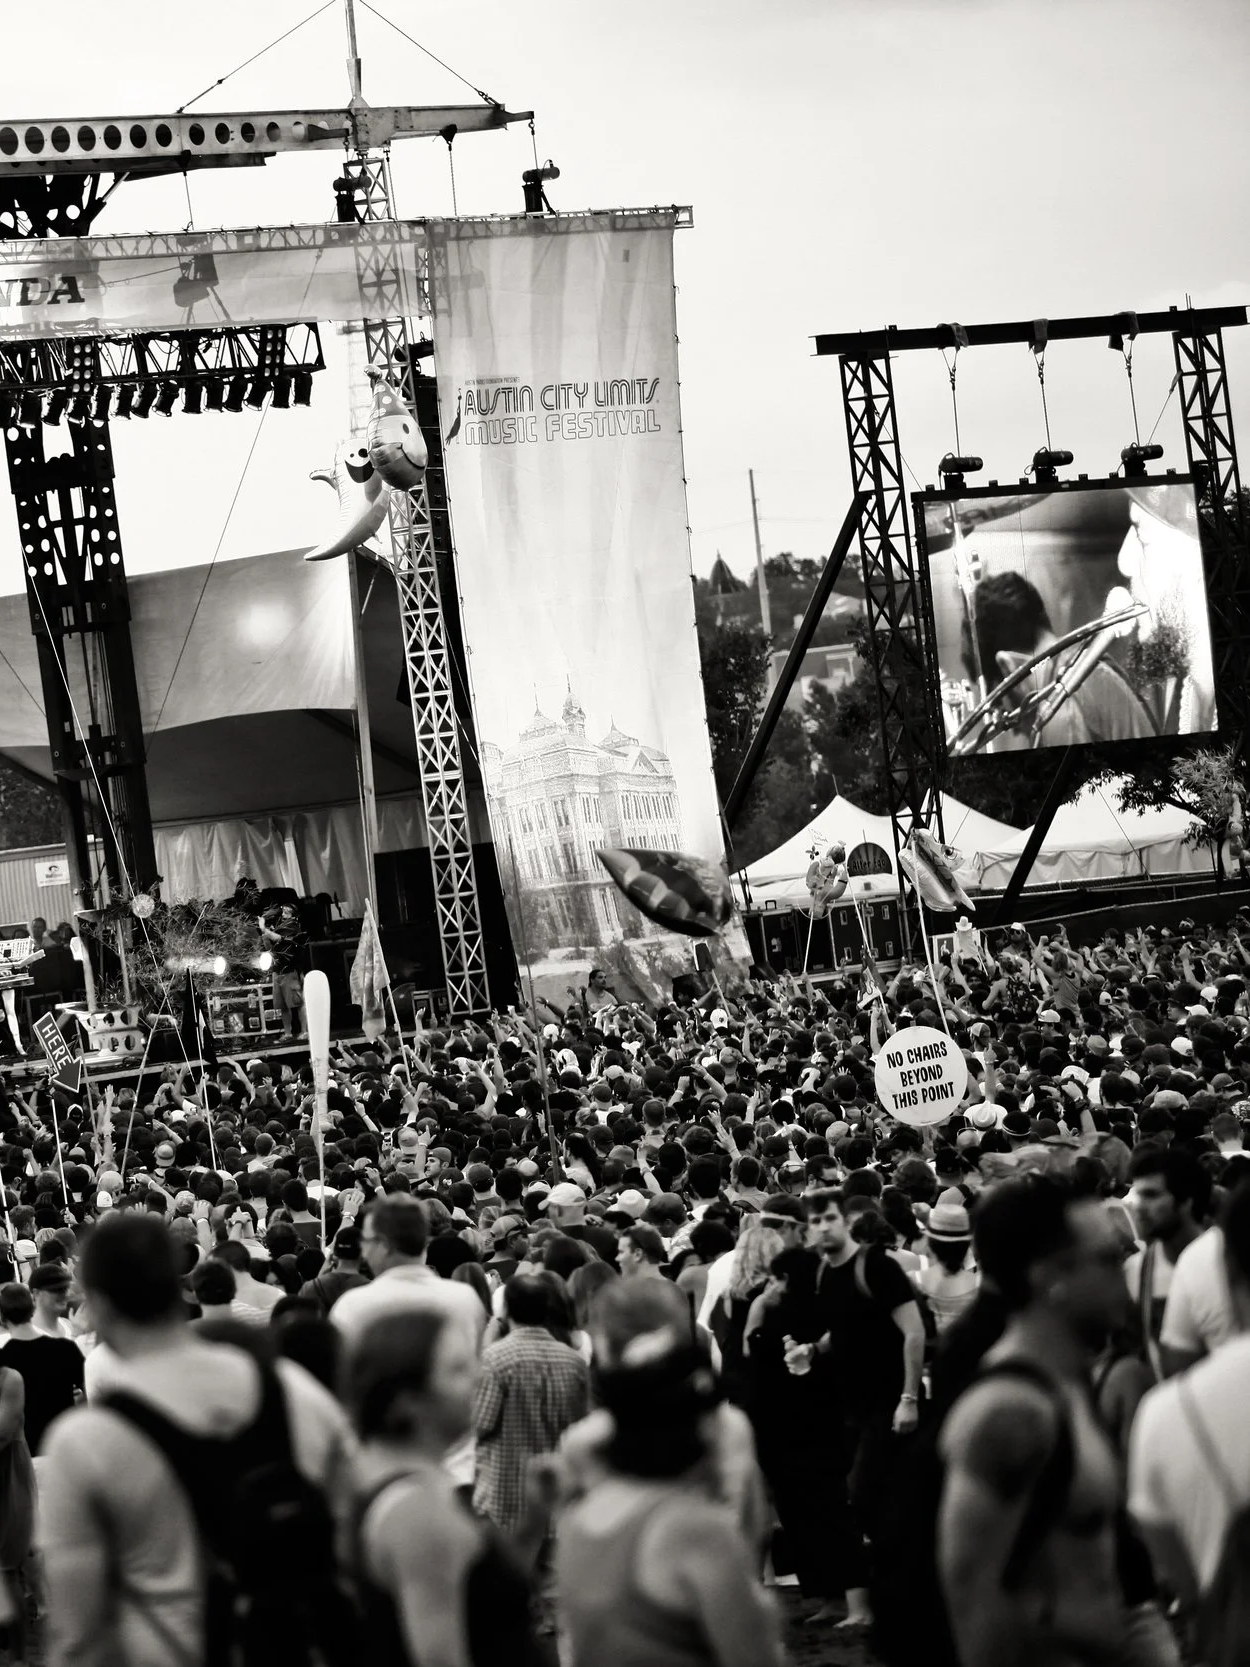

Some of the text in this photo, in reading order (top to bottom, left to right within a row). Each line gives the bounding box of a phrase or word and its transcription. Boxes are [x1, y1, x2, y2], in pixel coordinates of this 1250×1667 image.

[464, 377, 660, 416] AUSTIN CITY LIMITS
[464, 409, 662, 446] MUSIC FESTIVAL
[41, 1022, 72, 1071] HERE
[886, 1040, 948, 1069] NO CHAIRS
[899, 1063, 943, 1088] BEYOND
[892, 1081, 955, 1110] THIS POINT
